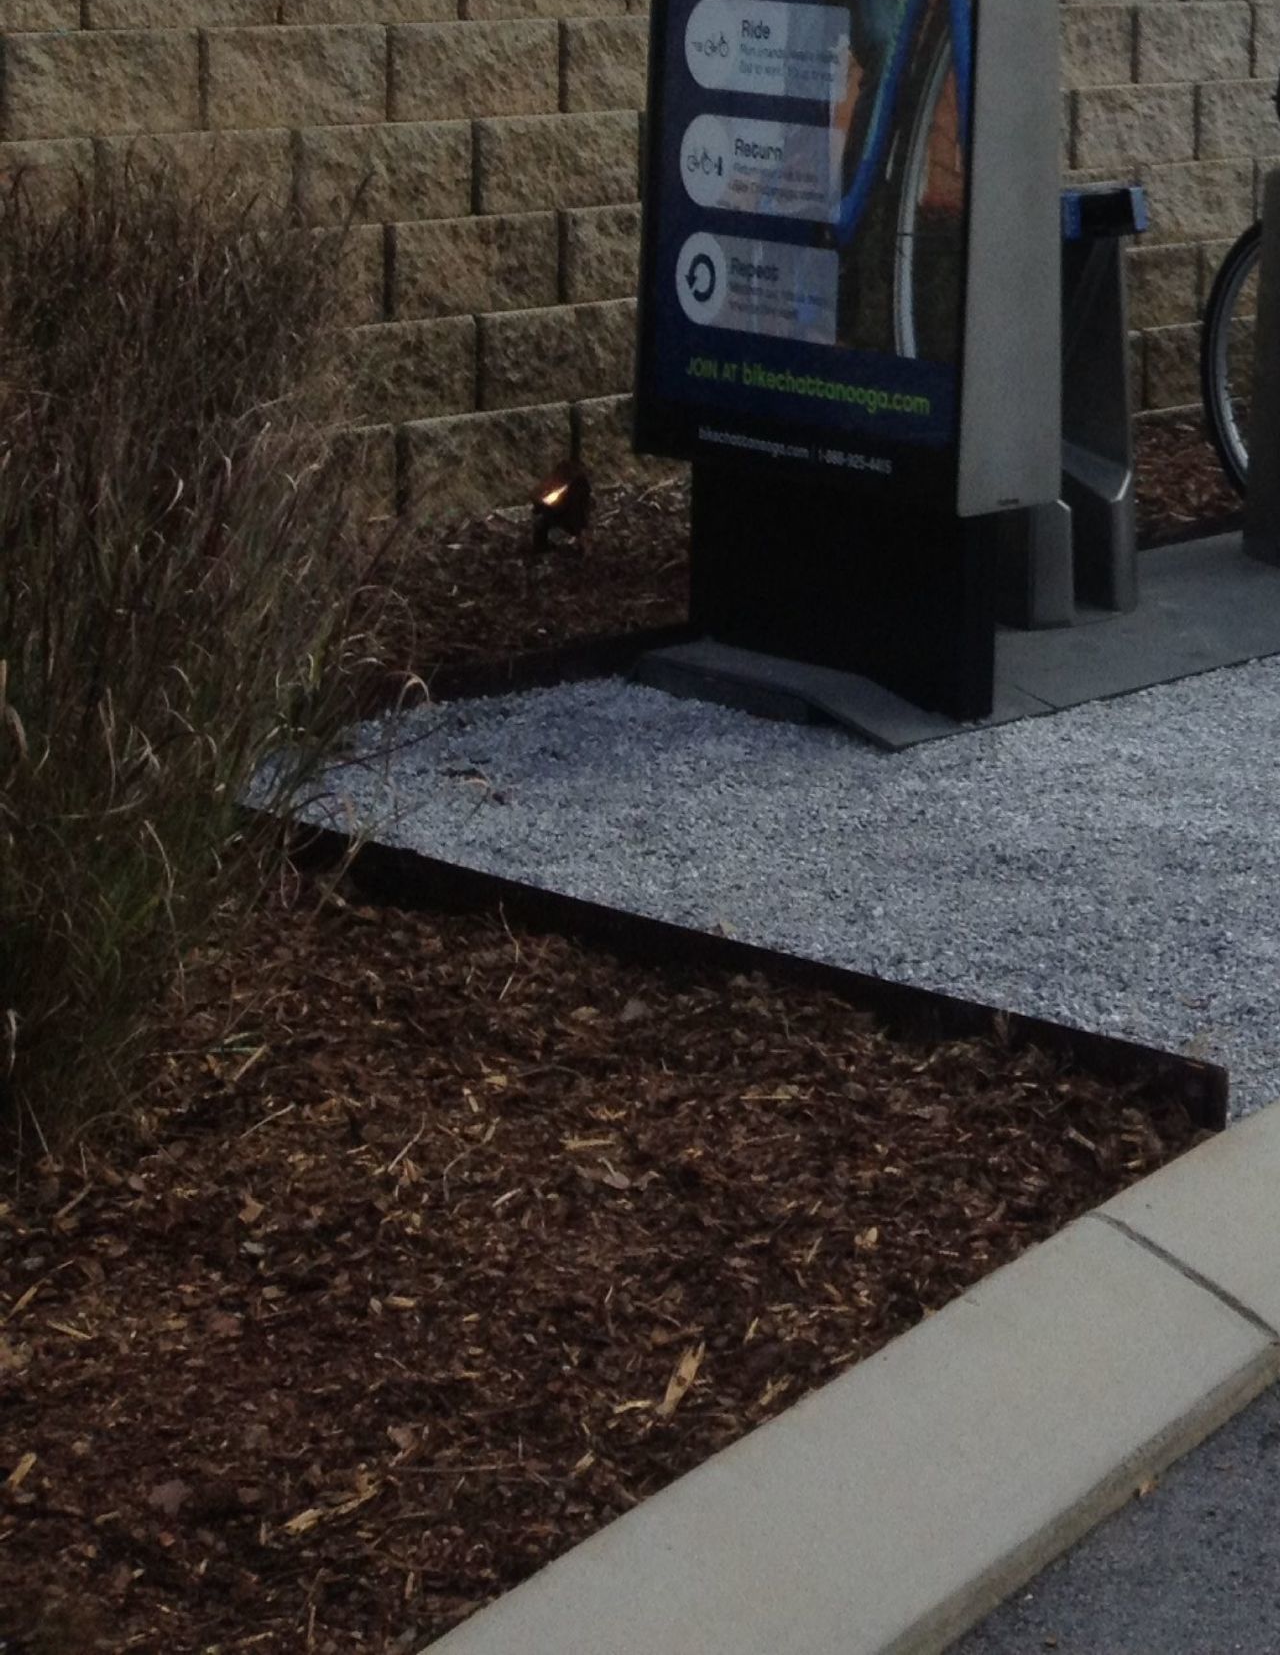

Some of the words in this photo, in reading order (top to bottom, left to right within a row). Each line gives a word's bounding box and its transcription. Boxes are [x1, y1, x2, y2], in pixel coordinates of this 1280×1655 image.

[741, 19, 771, 40] Ride
[734, 137, 784, 161] Return
[729, 256, 780, 282] Repeat
[686, 356, 718, 379] JOIN
[722, 360, 739, 381] AT
[741, 360, 931, 415] bikechattanooga.com
